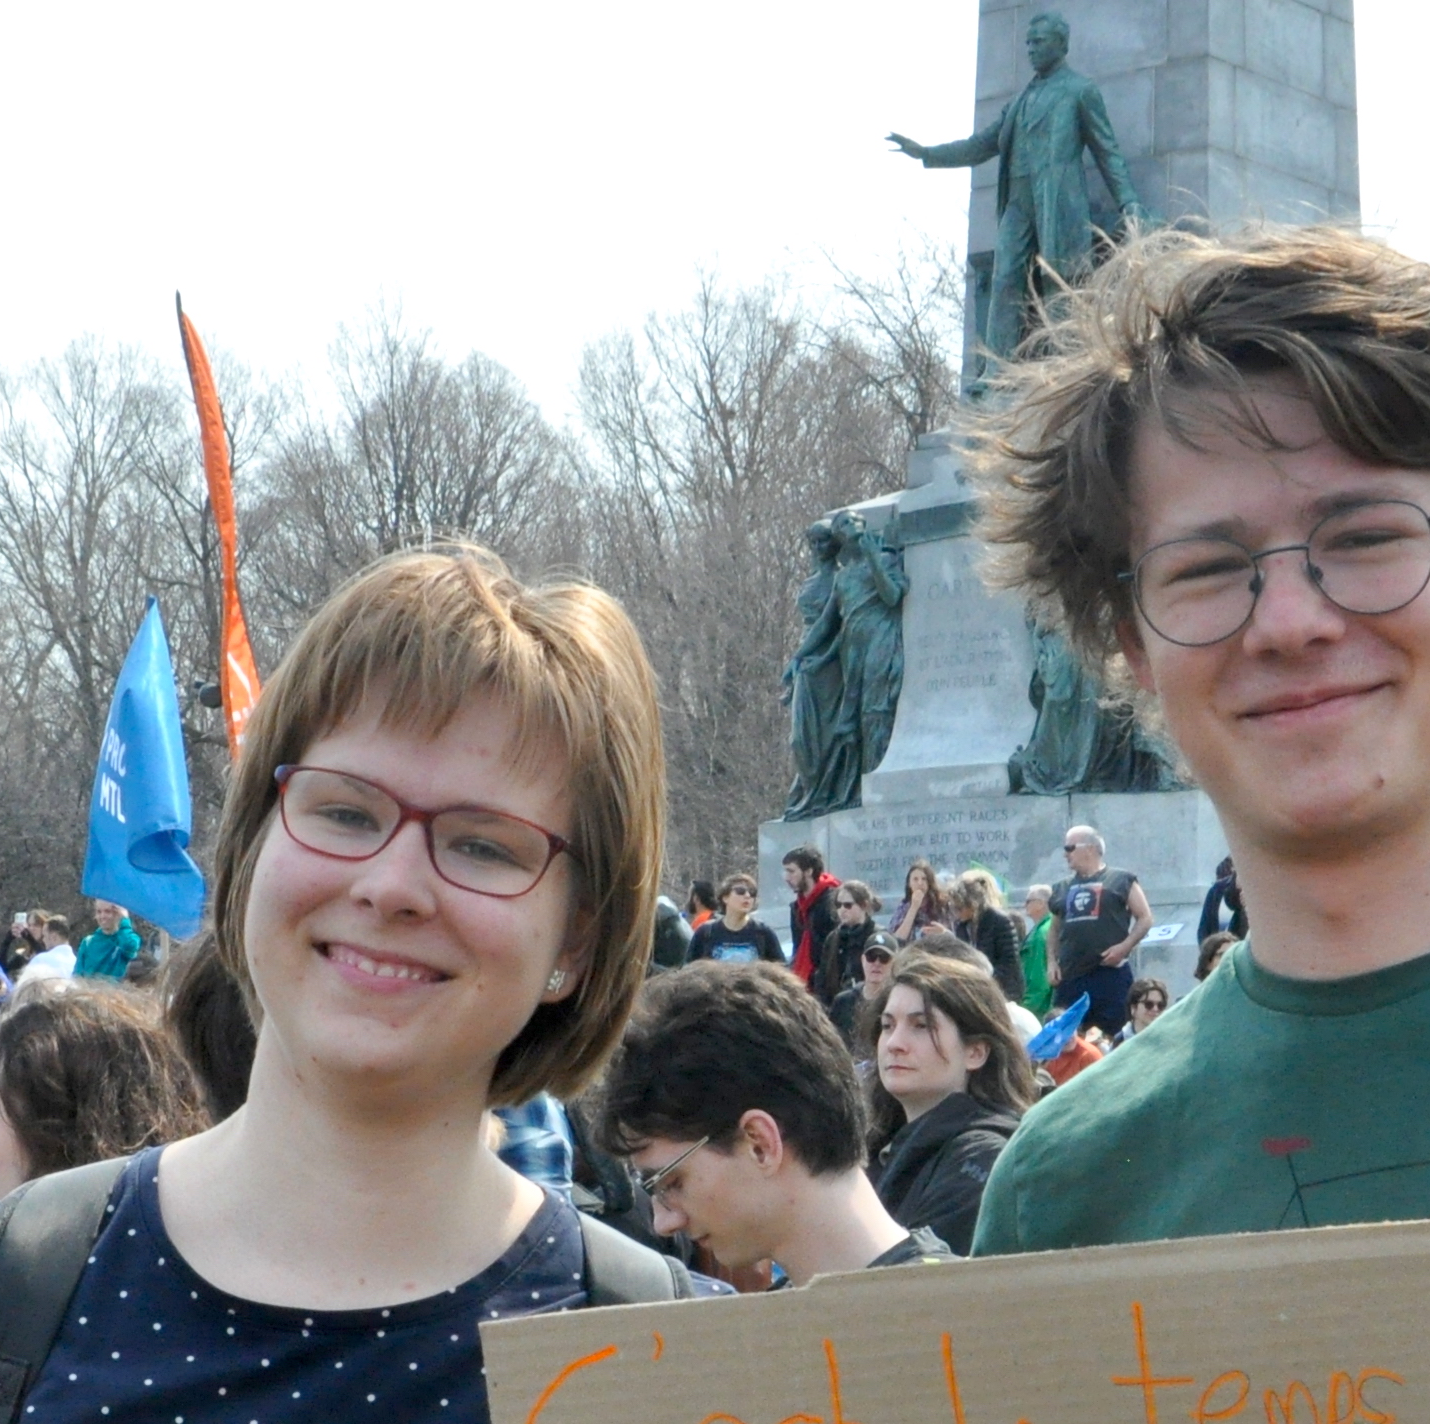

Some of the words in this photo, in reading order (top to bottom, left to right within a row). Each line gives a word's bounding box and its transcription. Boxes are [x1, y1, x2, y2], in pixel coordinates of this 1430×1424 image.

[100, 771, 127, 825] MTL
[969, 808, 1009, 823] RACES
[929, 831, 952, 847] BUT
[956, 831, 972, 846] TO
[975, 829, 1010, 843] WORK
